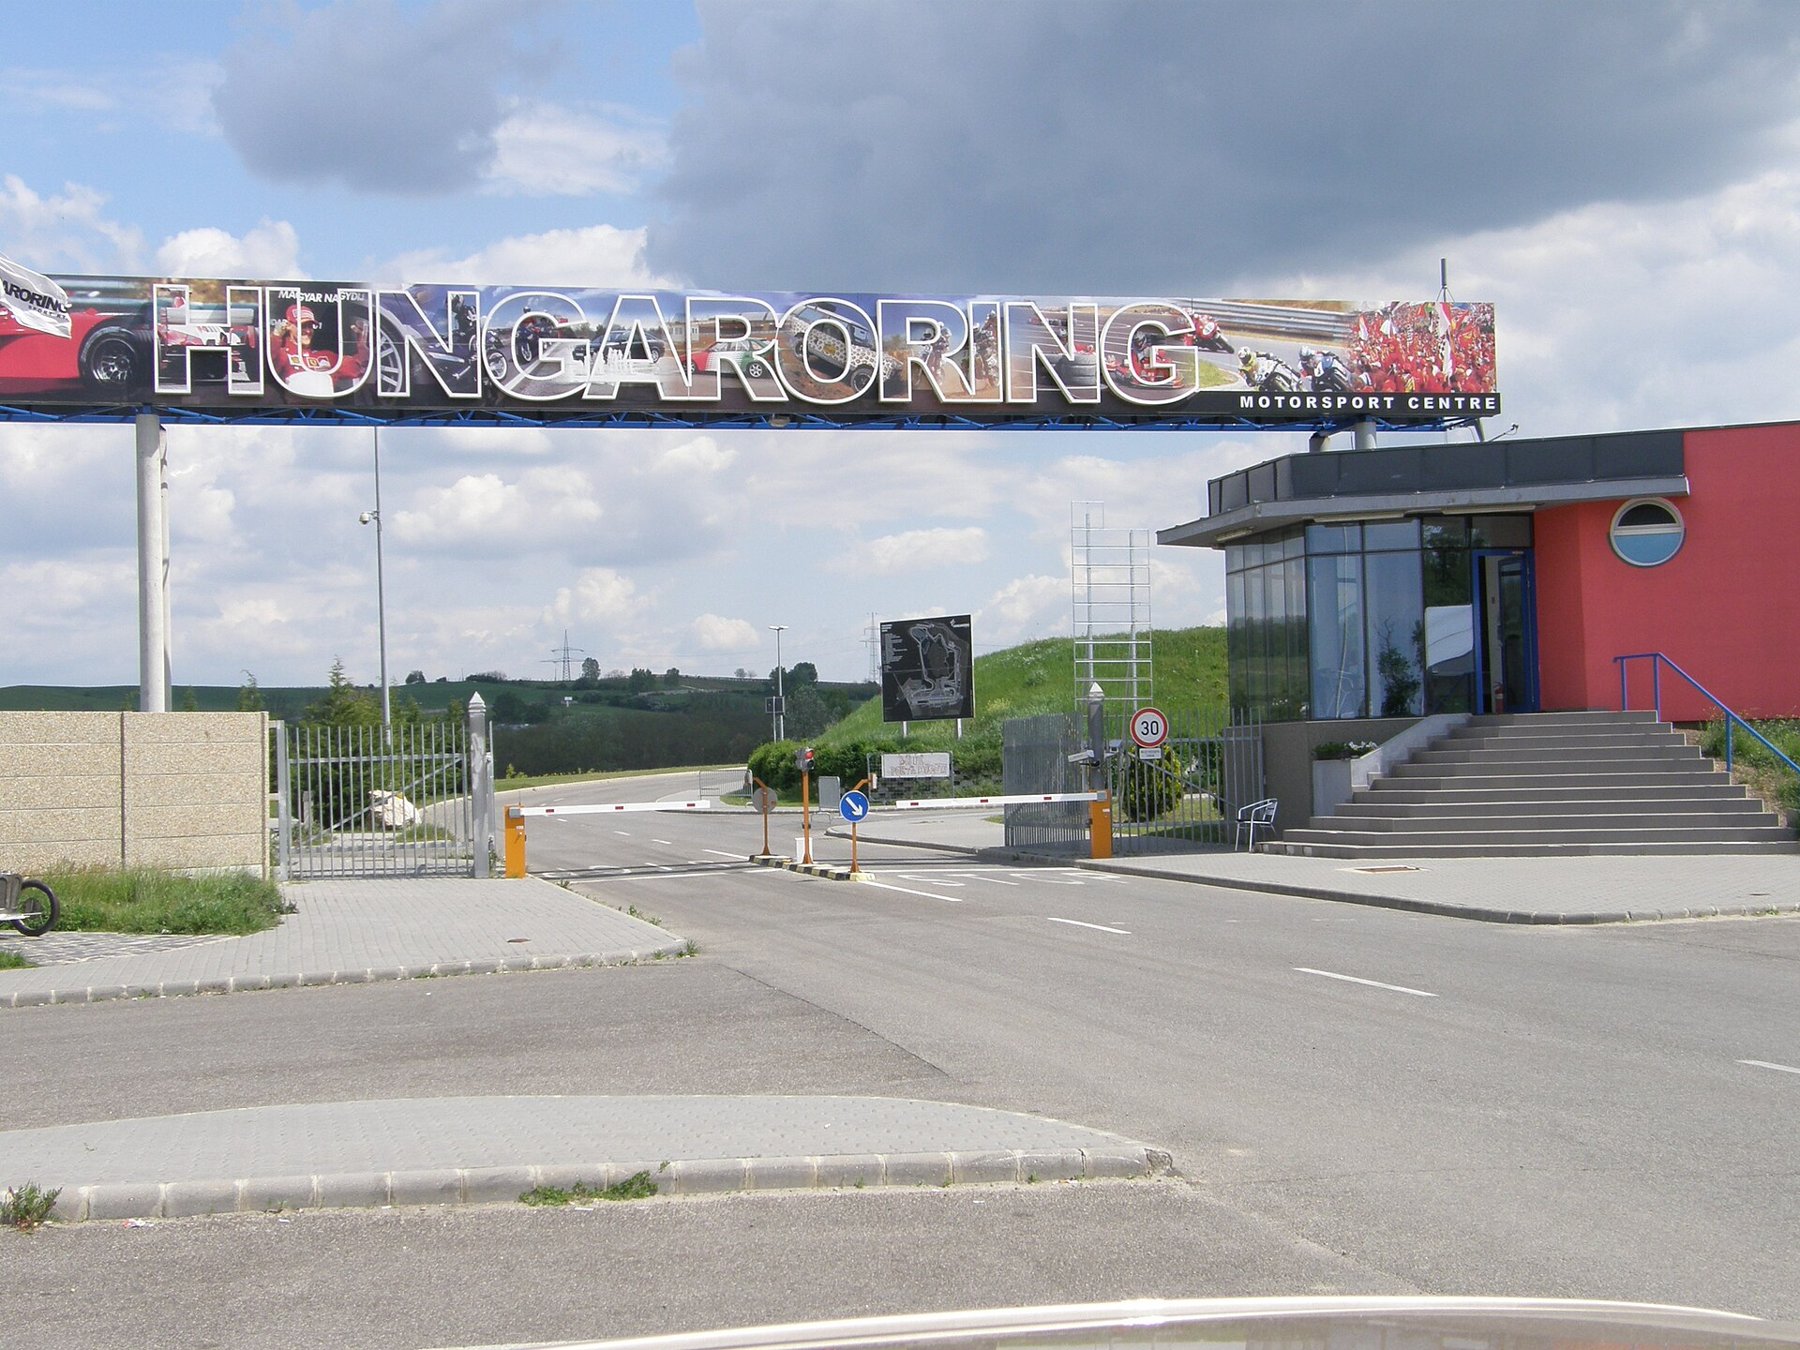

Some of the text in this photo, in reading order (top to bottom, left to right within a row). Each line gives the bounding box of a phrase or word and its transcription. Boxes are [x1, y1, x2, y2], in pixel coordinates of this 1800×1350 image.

[153, 283, 1199, 405] HUNGARORING
[1239, 395, 1497, 411] MOTORSPORT CENTRE
[1141, 720, 1159, 736] 30
